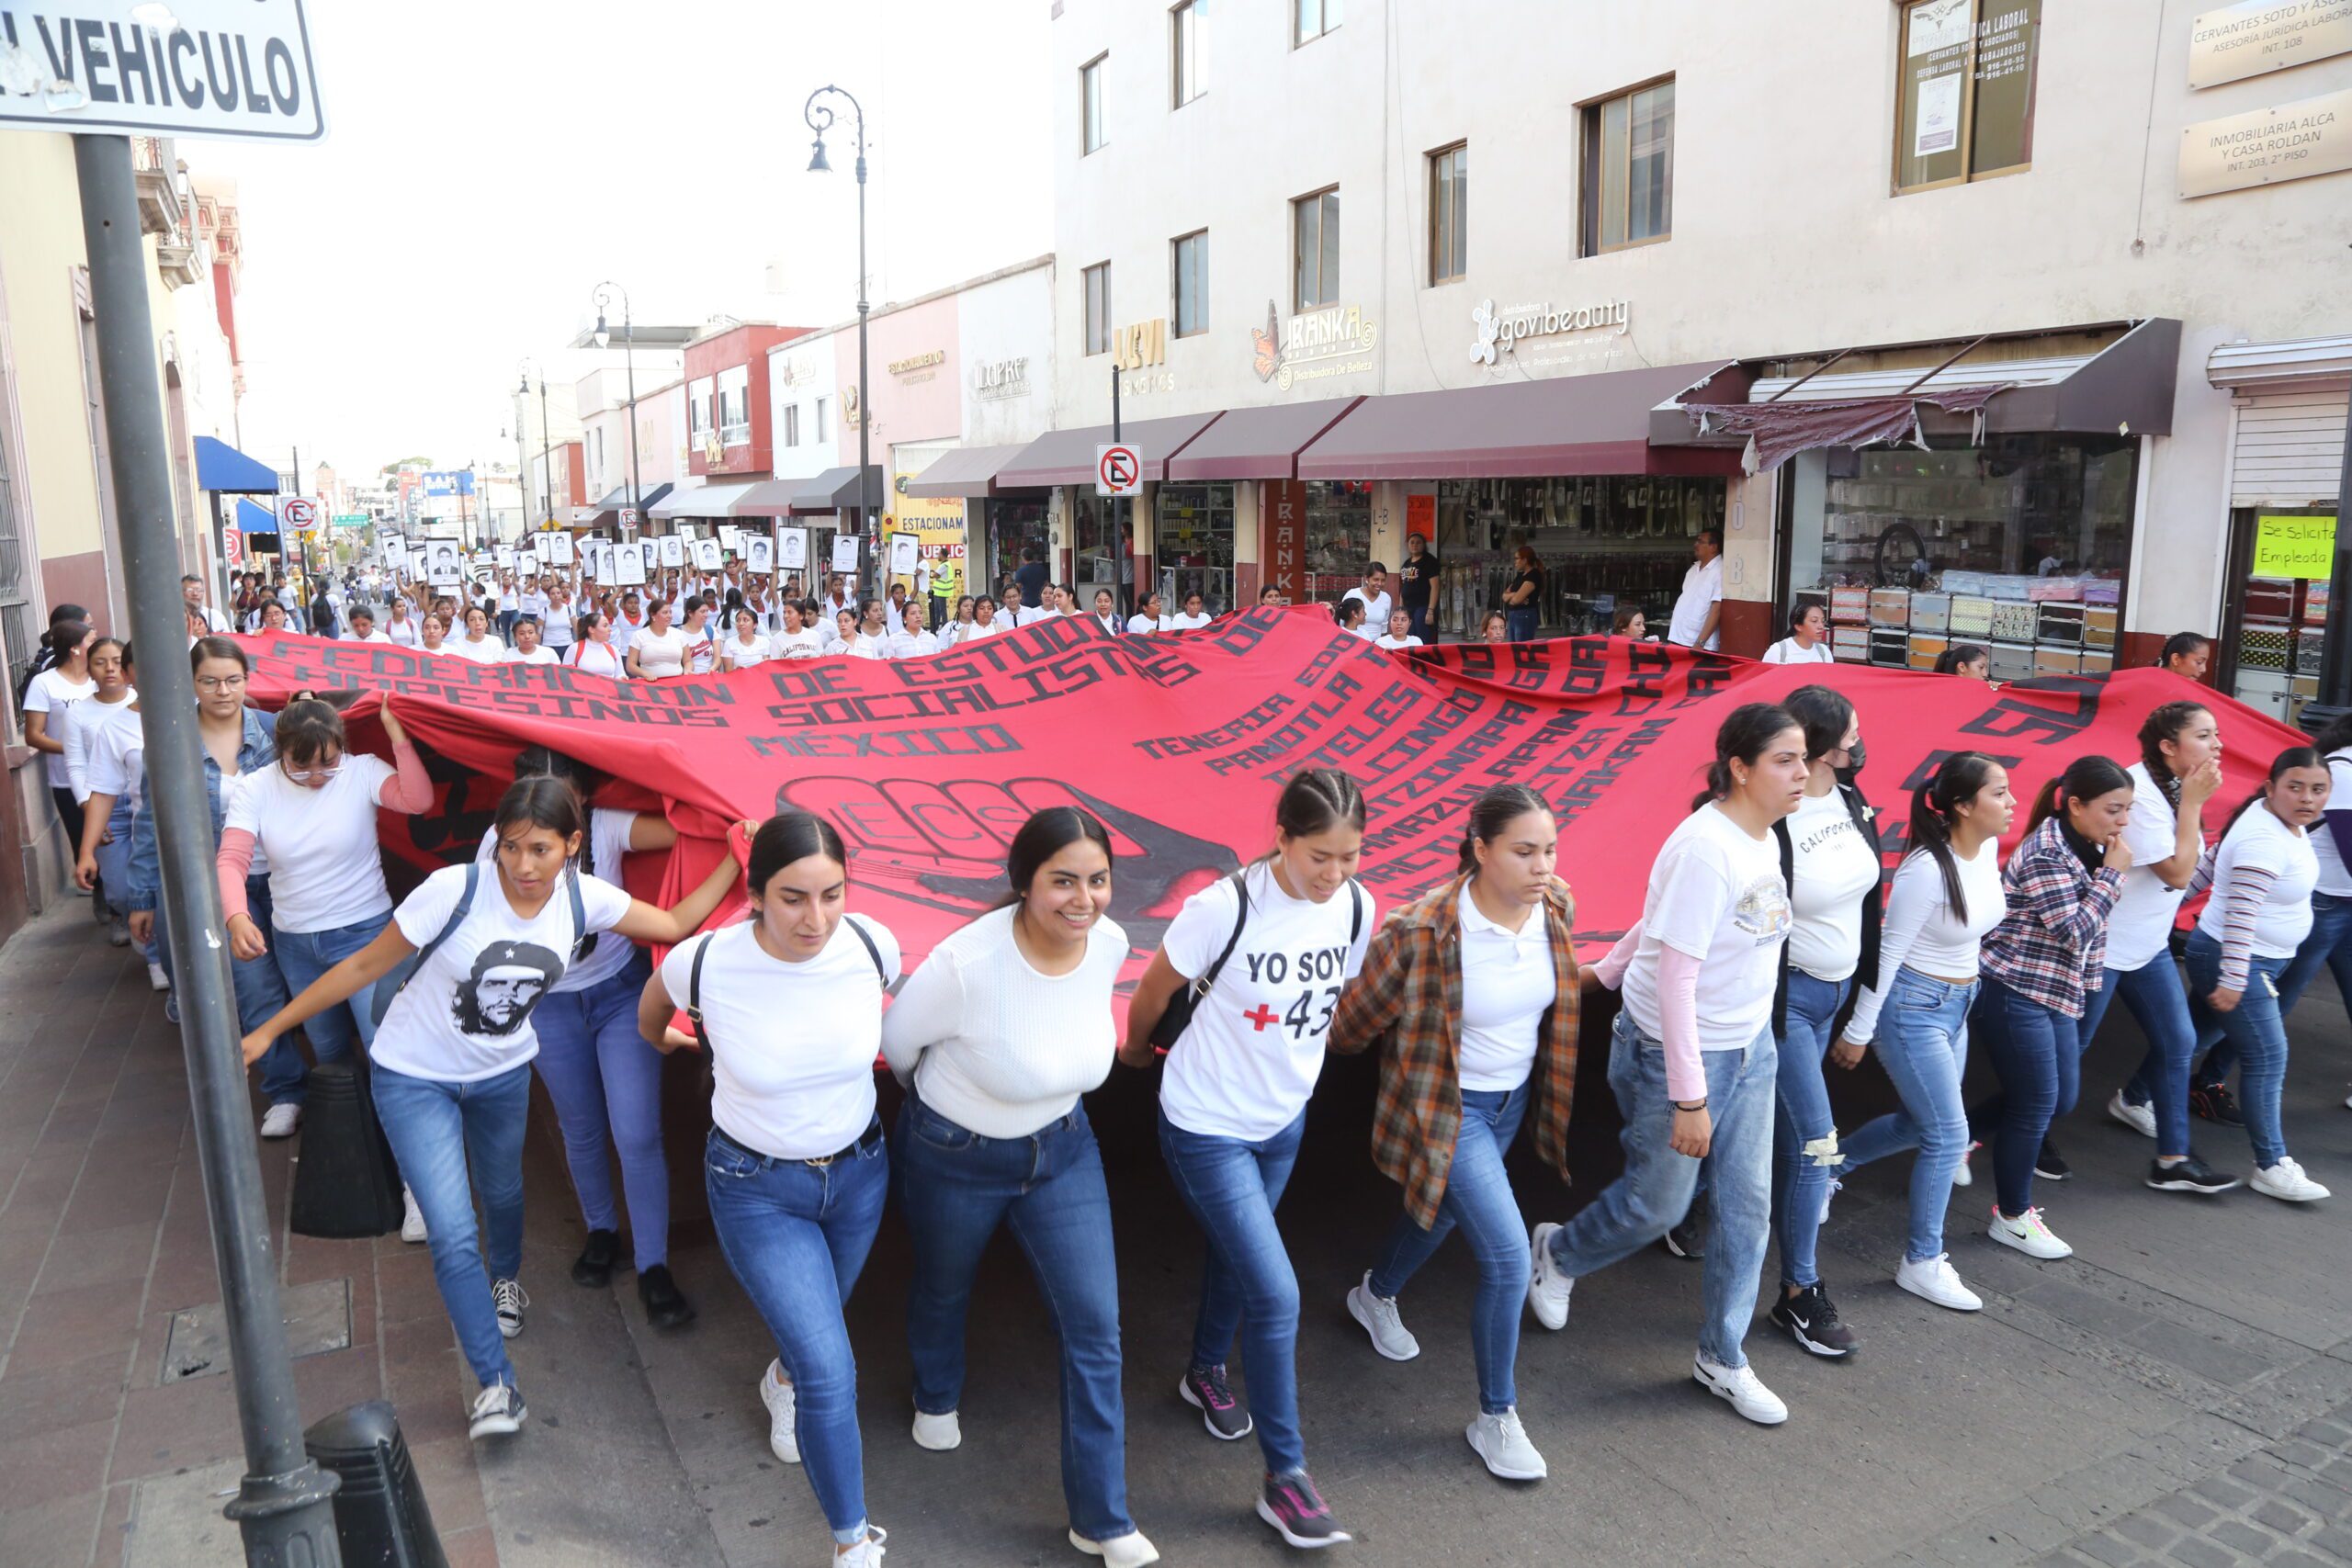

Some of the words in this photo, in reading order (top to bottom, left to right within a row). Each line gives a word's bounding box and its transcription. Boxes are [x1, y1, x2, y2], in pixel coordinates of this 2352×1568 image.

[1994, 8, 2029, 33] LABORAL
[2194, 16, 2260, 43] CERVANTES
[2263, 6, 2297, 25] SOTO
[2301, 3, 2308, 13] Y
[2284, 37, 2303, 50] 108
[2210, 120, 2298, 148] INMOBILIARIA
[2301, 112, 2335, 129] ALCA
[2222, 149, 2230, 160] Y
[2232, 142, 2264, 158] CASA
[2267, 130, 2322, 151] ROLDAN
[2285, 149, 2309, 161] PISO
[1500, 298, 1631, 352] govibeauty
[1106, 372, 1175, 399] CSMETICS
[1294, 367, 1336, 381] Distribuidora
[1336, 365, 1346, 375] De
[1347, 361, 1373, 374] Belleza
[2263, 521, 2282, 537] Se
[2260, 547, 2326, 568] Empleada
[1213, 604, 1287, 657] DE
[770, 664, 863, 699] DE
[1132, 693, 1296, 760] TENERIA
[1204, 671, 1364, 776] PANOTLA
[1799, 819, 1860, 853] CALIFORNI
[1246, 953, 1288, 984] YO
[1297, 946, 1347, 982] SOY
[1284, 986, 1341, 1039] 43
